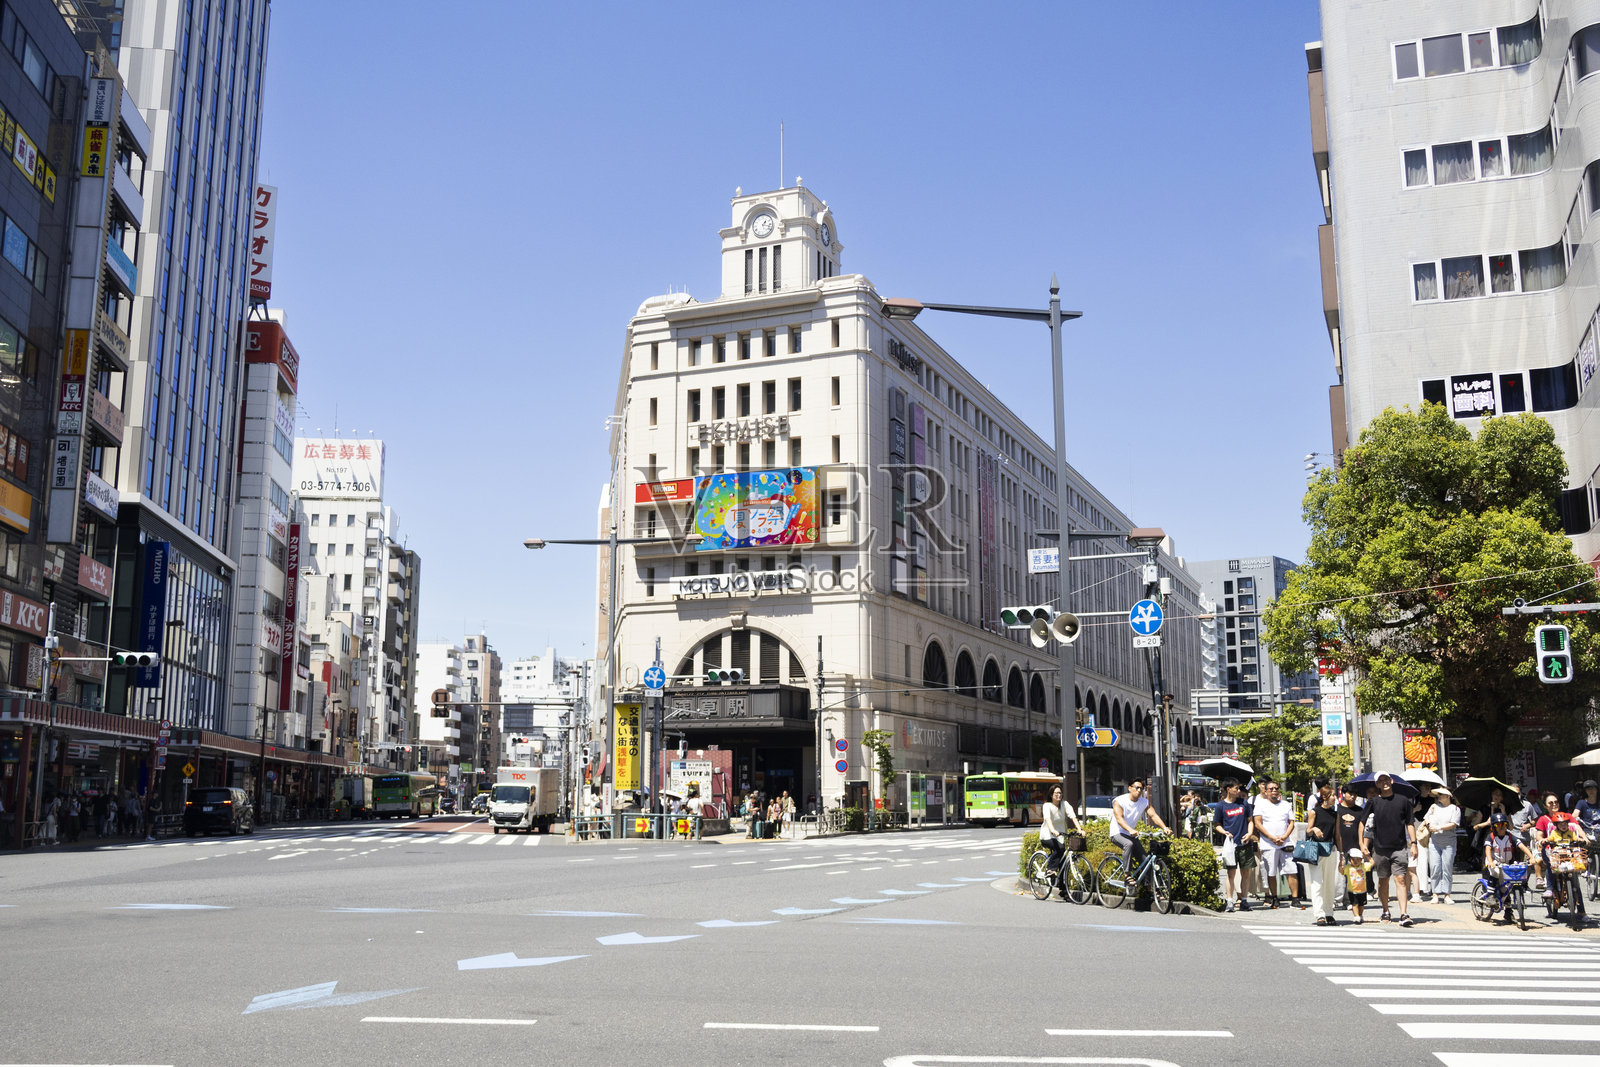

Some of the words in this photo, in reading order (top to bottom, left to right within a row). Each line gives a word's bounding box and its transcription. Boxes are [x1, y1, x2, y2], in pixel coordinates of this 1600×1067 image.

[61, 402, 82, 411] KFC
[1453, 391, 1495, 412] 歯科
[698, 415, 788, 443] EKIMISE
[304, 444, 371, 460] 広告募集
[301, 481, 370, 492] 03-5774-7506
[153, 550, 163, 584] MIZUHO
[288, 536, 299, 570] カラオケ
[17, 602, 44, 631] KFC
[148, 605, 157, 640] みずほ銀行
[283, 624, 295, 659] カラオケ
[675, 699, 746, 717] 浅草駅
[629, 706, 639, 757] 交通事故の
[1079, 732, 1096, 743] 463
